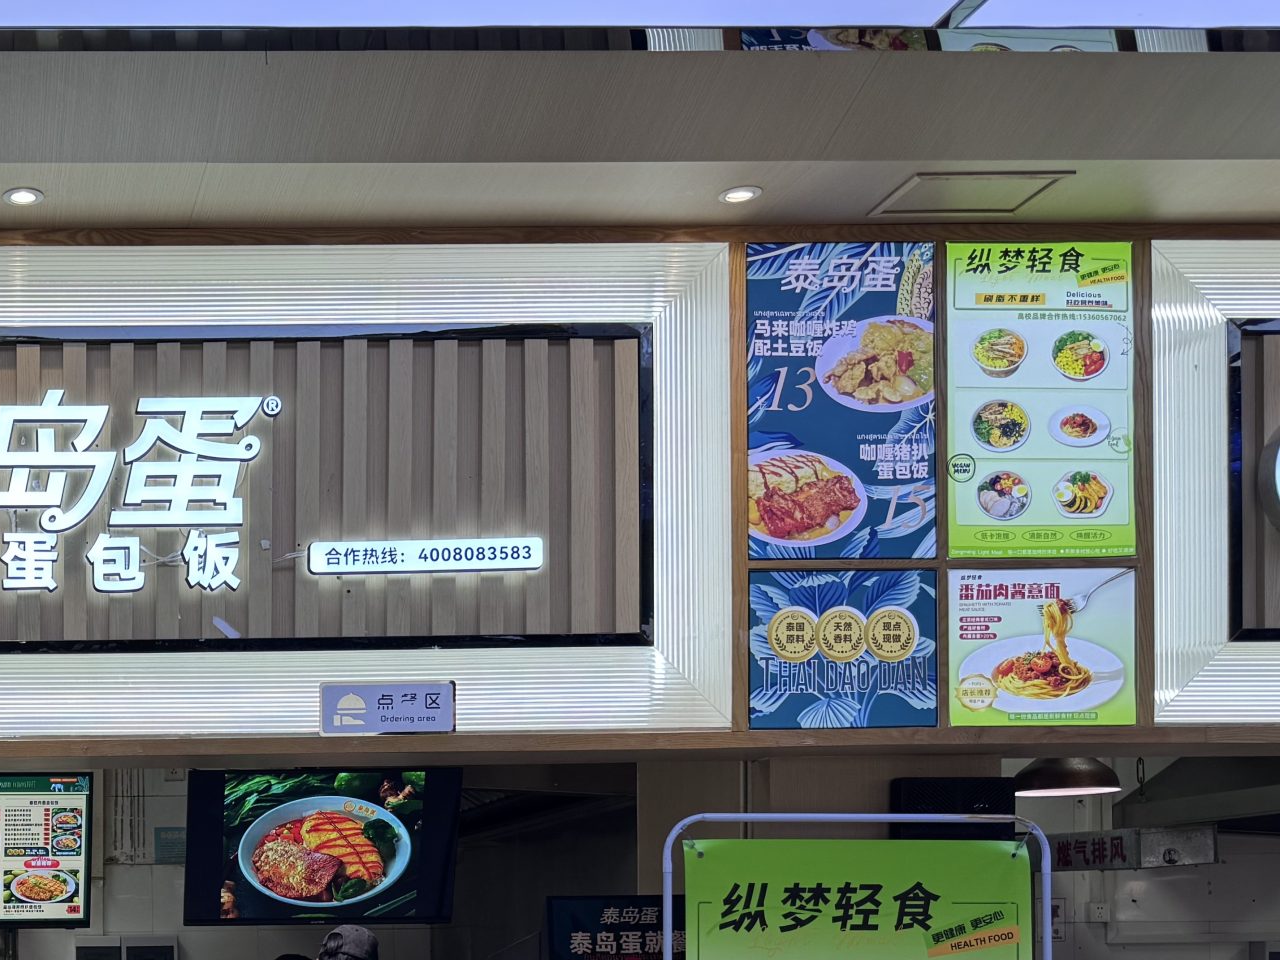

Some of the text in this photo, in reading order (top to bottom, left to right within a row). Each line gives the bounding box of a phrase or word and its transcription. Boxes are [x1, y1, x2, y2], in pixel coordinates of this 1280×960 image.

[965, 246, 1085, 275] 纵梦轻食
[780, 255, 901, 293] 泰岛蛋
[755, 319, 857, 338] 马来咖喱炸鸡
[754, 339, 823, 357] 配土豆饭
[859, 443, 929, 461] 咖喱猪扒
[877, 462, 929, 479] 蛋包饭
[418, 545, 532, 563] 4008083583
[959, 582, 1061, 600] 番茄肉酱意面
[786, 622, 805, 632] 泰国
[833, 622, 853, 632] 天然
[882, 622, 902, 632] 现点
[786, 634, 805, 644] 原料
[833, 634, 853, 644] 香料
[882, 634, 902, 644] 现做
[759, 656, 928, 693] THAI DAO DAN
[380, 715, 415, 723] Ordering
[600, 906, 659, 925] 泰岛蛋
[719, 881, 941, 934] 纵梦轻食
[931, 909, 1005, 945] 更健康 更安心
[949, 931, 1015, 951] HEALTH FOOD
